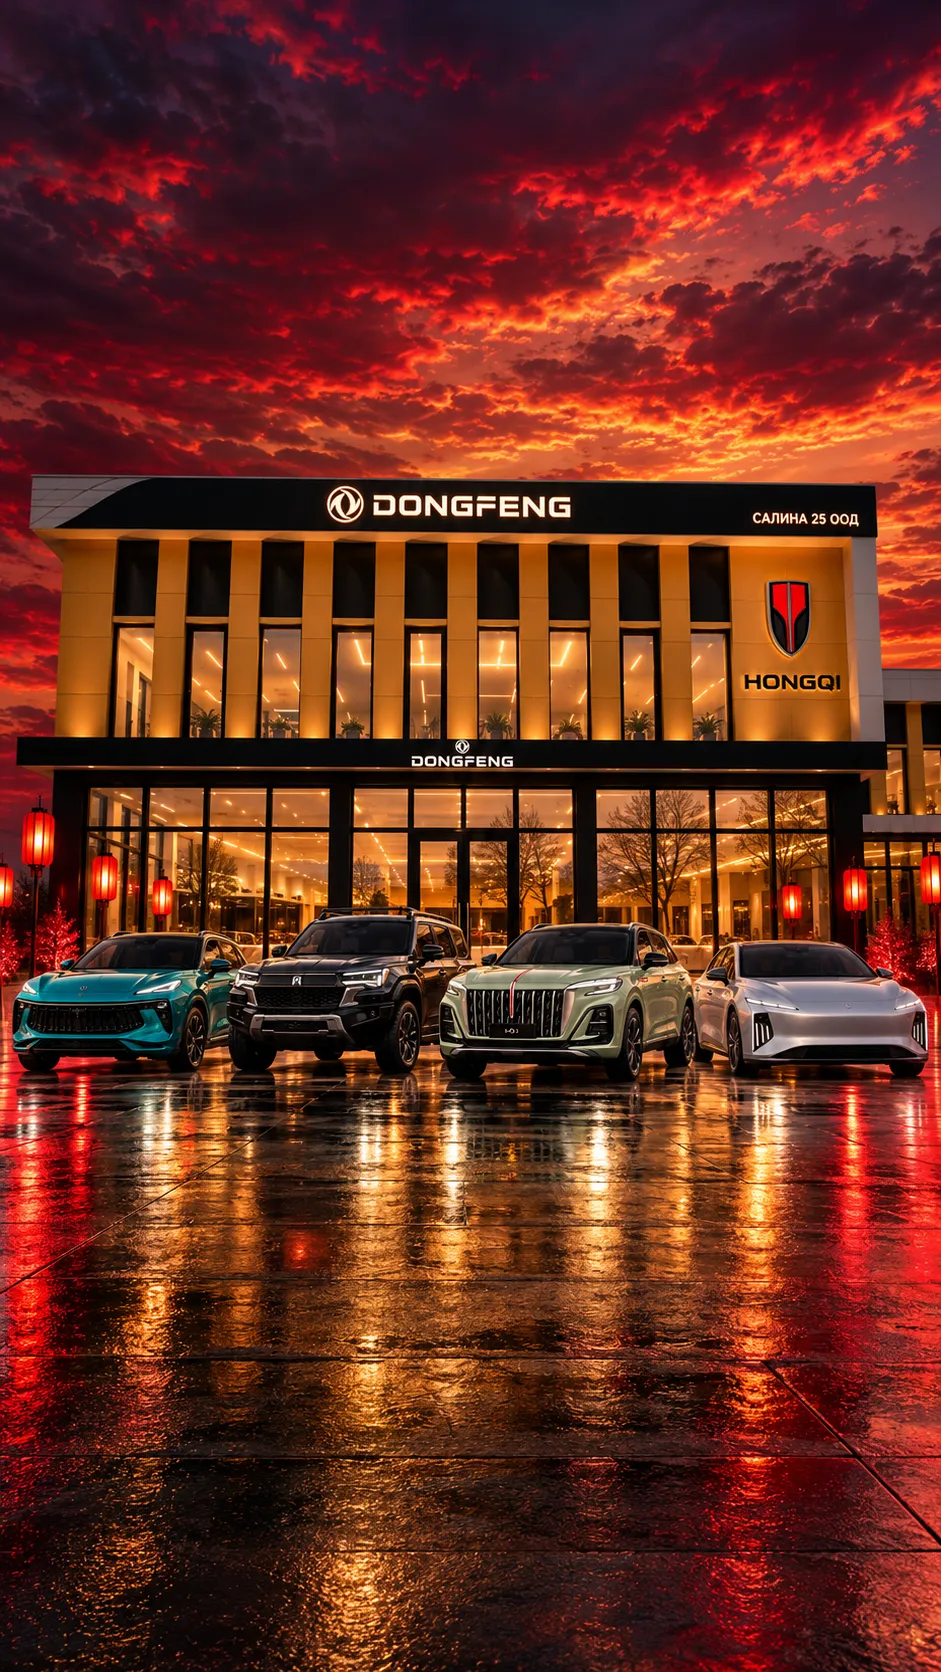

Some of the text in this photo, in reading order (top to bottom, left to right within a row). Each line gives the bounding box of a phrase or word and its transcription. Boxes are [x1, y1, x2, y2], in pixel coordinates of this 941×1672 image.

[373, 494, 571, 518] DONGFENG
[752, 512, 859, 527] САЛИНА 25 ООД
[744, 674, 841, 691] HONGQI
[411, 755, 514, 767] DONGFENG
